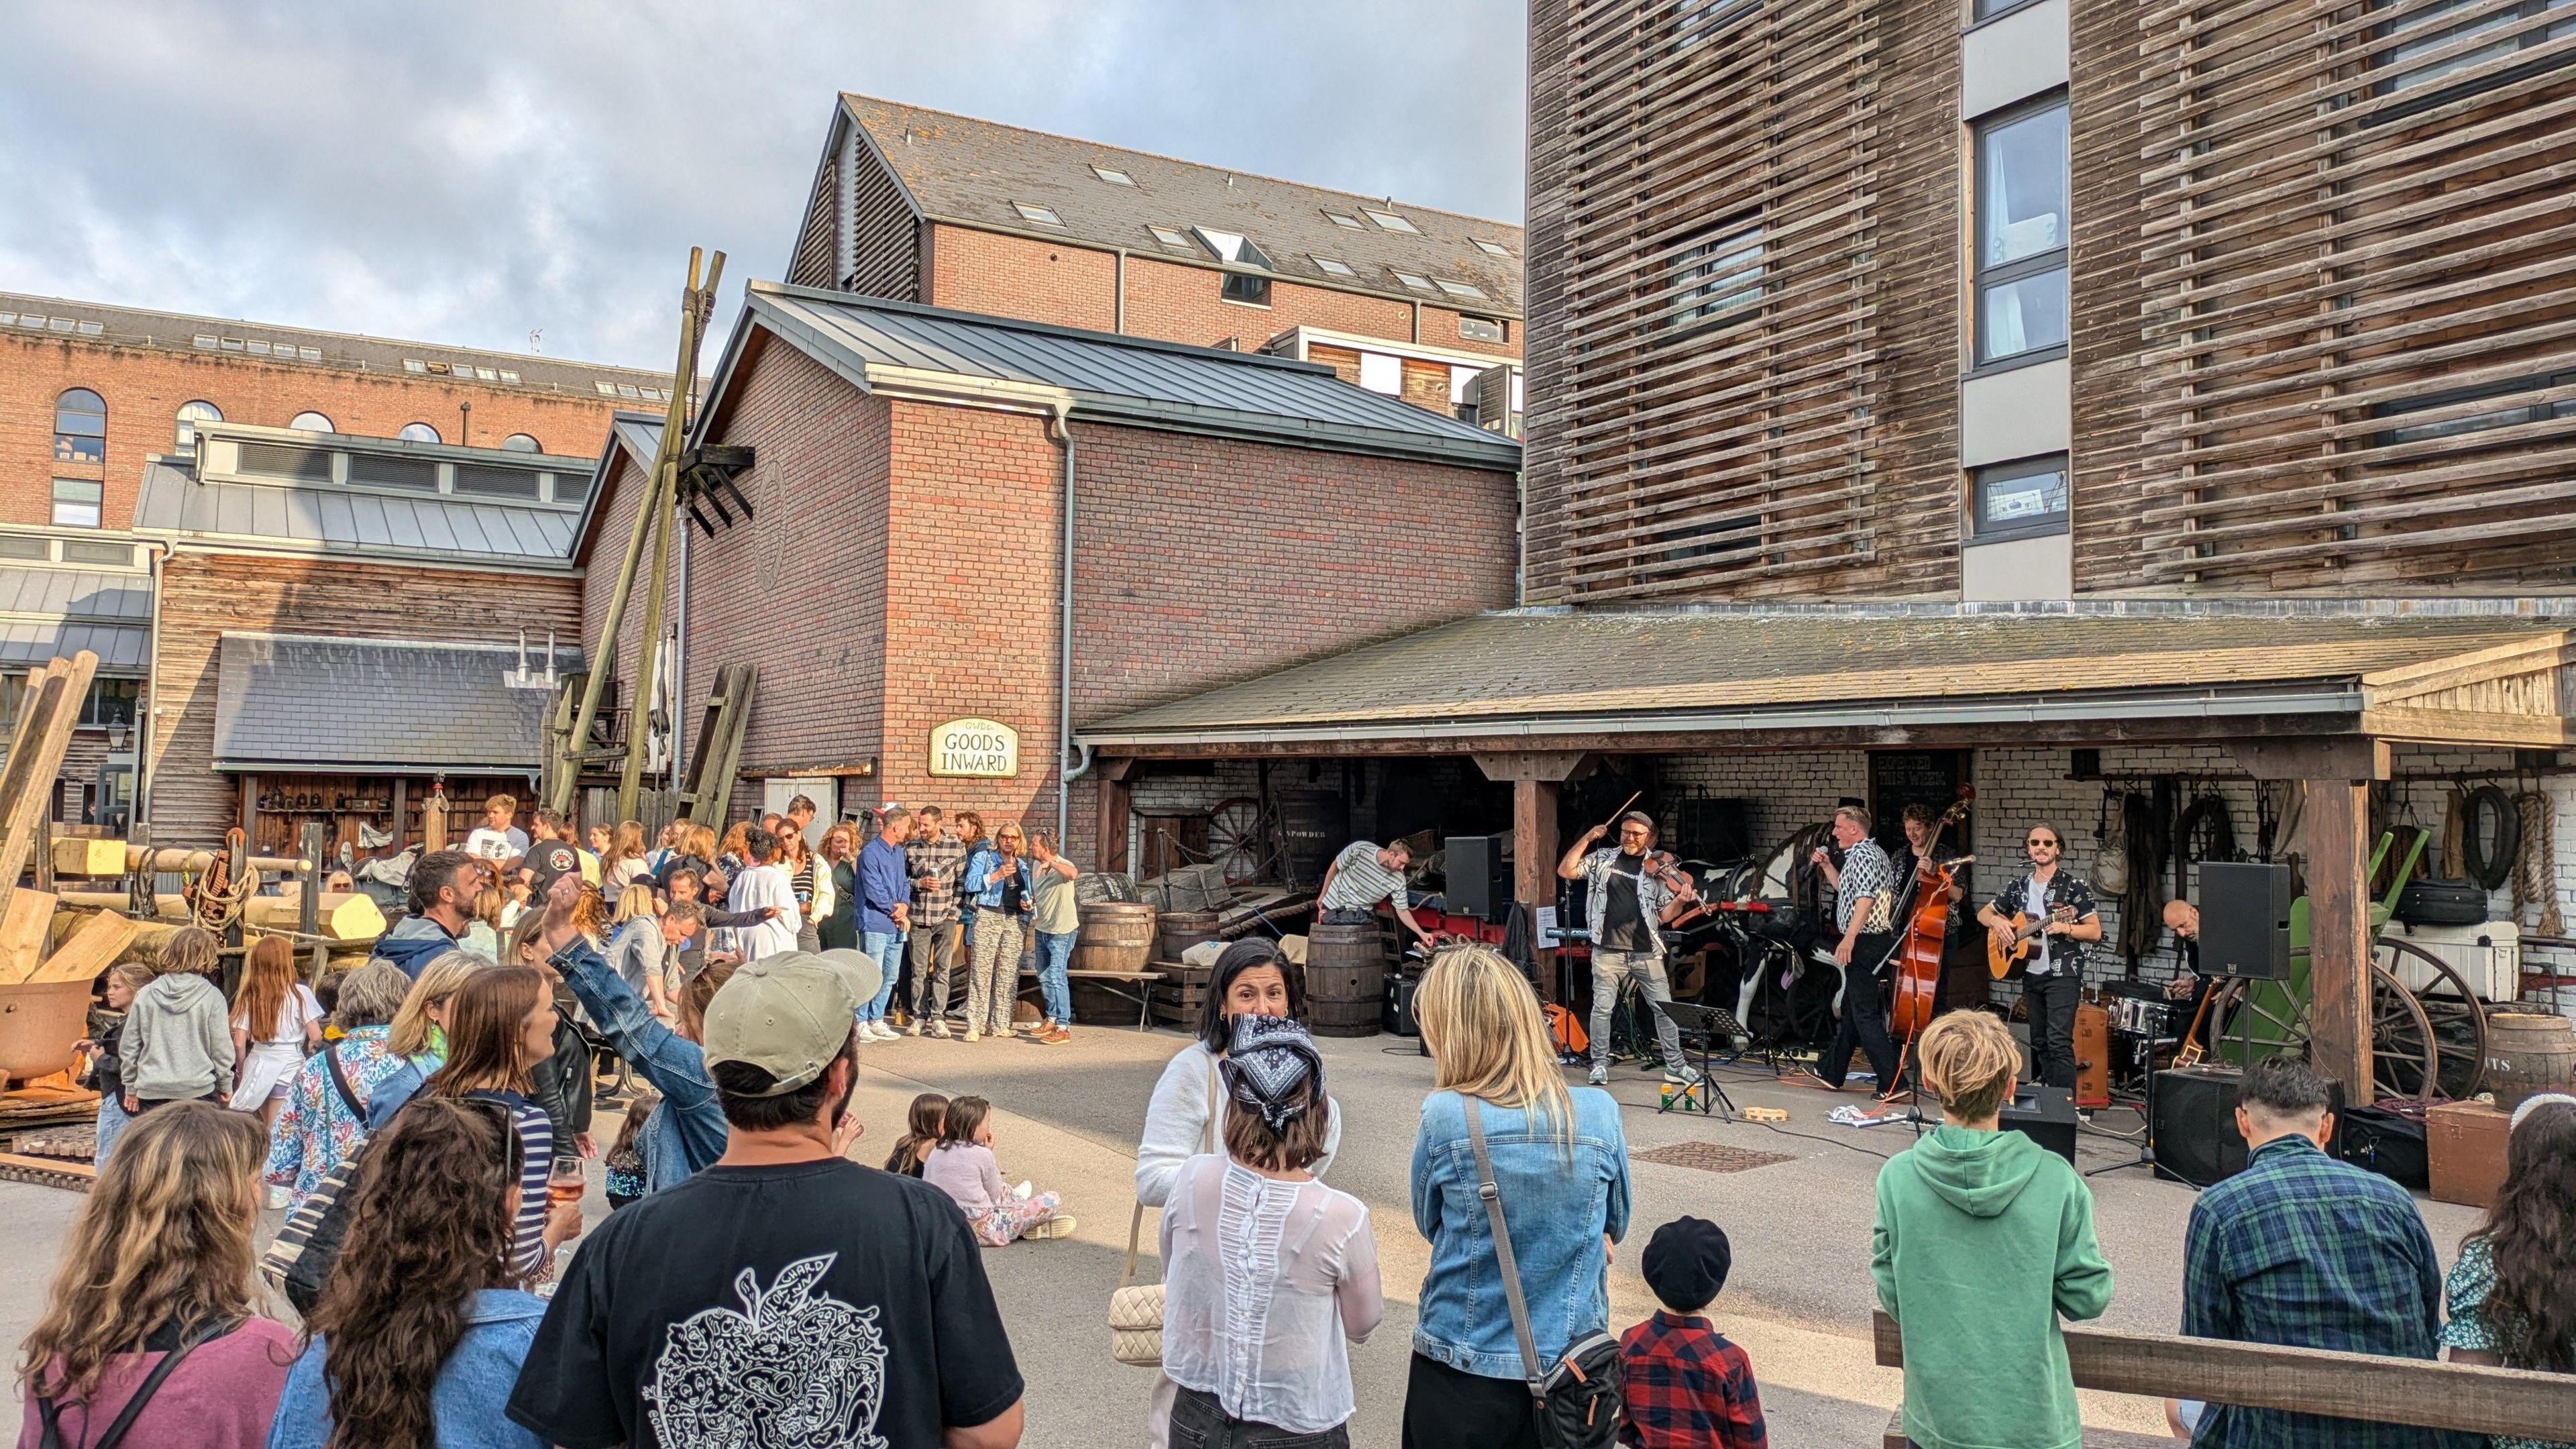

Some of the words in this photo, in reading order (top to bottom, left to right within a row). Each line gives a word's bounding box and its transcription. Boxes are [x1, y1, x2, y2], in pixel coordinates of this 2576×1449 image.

[945, 733, 1005, 751] GOODS
[941, 753, 1007, 771] INWARD
[1878, 755, 1931, 770] EXPECTED
[1878, 771, 1905, 786] THIS
[1909, 771, 1946, 786] WEEK
